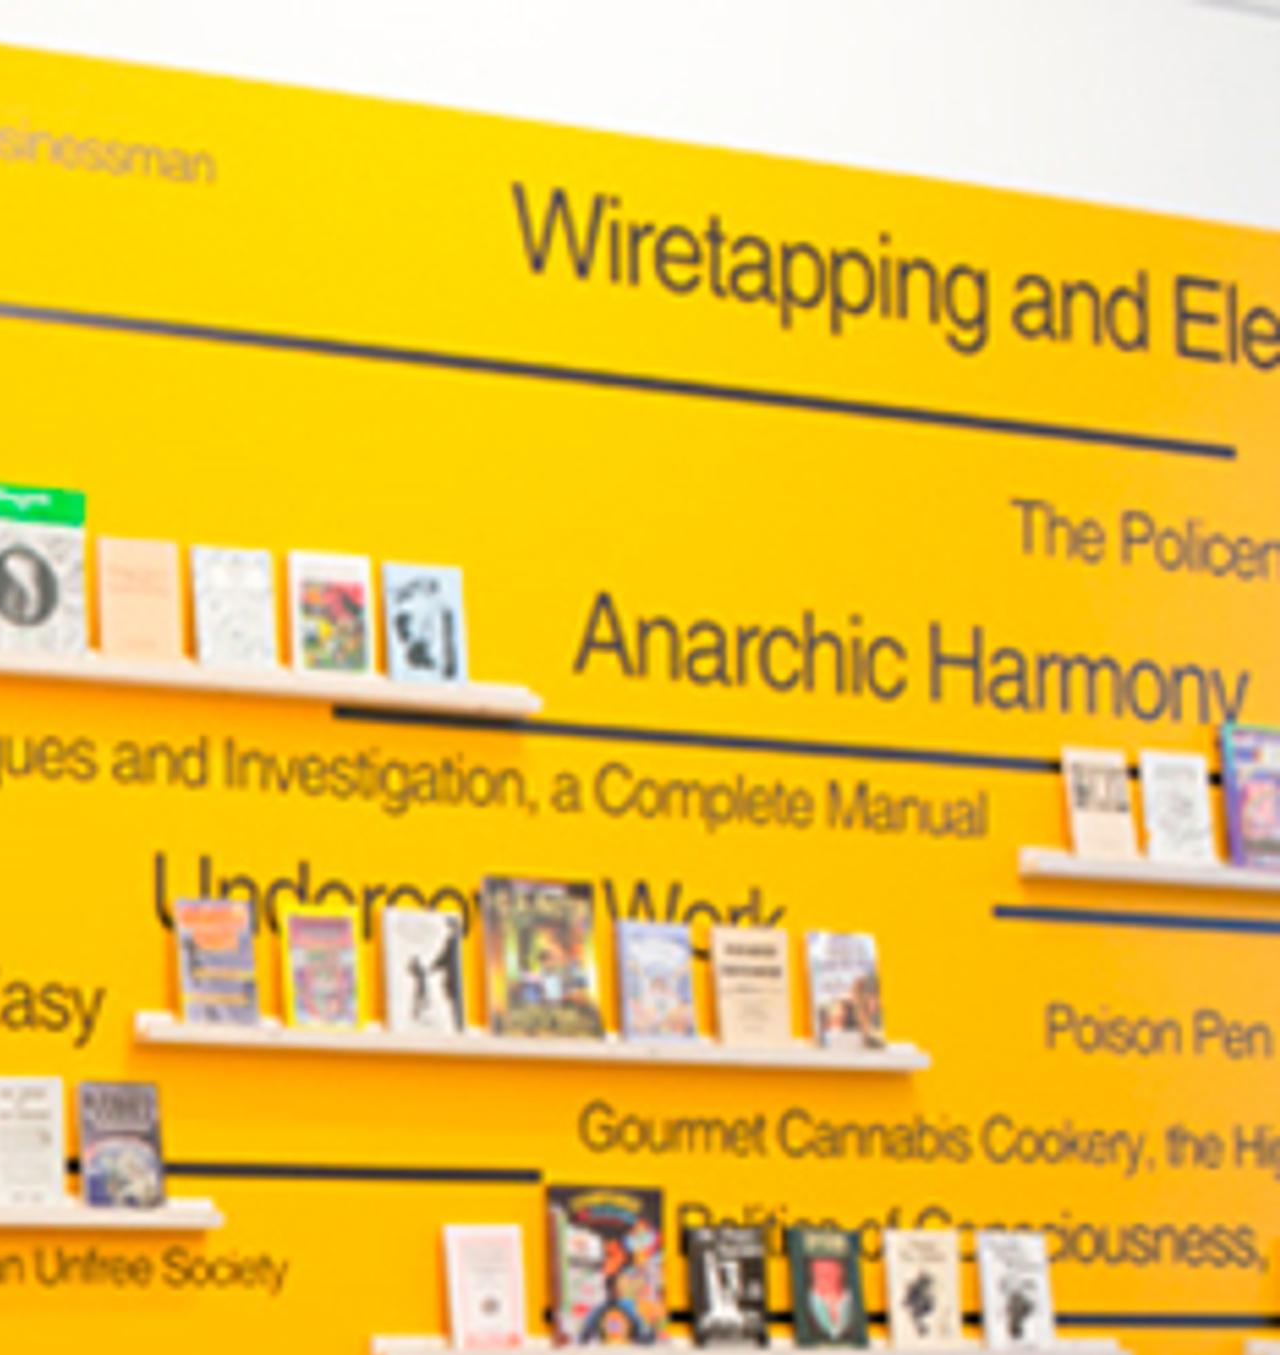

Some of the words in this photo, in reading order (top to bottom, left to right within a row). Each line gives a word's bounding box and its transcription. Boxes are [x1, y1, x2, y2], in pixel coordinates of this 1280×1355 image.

[511, 181, 991, 358] Wiretapping
[1010, 269, 1151, 353] and
[1010, 498, 1106, 565] The
[572, 590, 908, 703] Anarchic
[929, 620, 1252, 724] Harmony
[111, 735, 209, 789] and
[223, 735, 542, 818] Investigation,
[551, 772, 581, 813] a
[594, 761, 814, 830] Complete
[827, 779, 988, 838] Manual
[1046, 1002, 1182, 1057] Poison
[1193, 1008, 1273, 1060] Pen
[578, 1098, 767, 1158] Gourmet
[776, 1107, 973, 1164] Cannabis
[980, 1110, 1158, 1180] Cookery,
[1165, 1125, 1225, 1170] the
[34, 1247, 153, 1287] Unfree
[159, 1246, 292, 1304] Society
[916, 1200, 1272, 1276] Cociousness,
